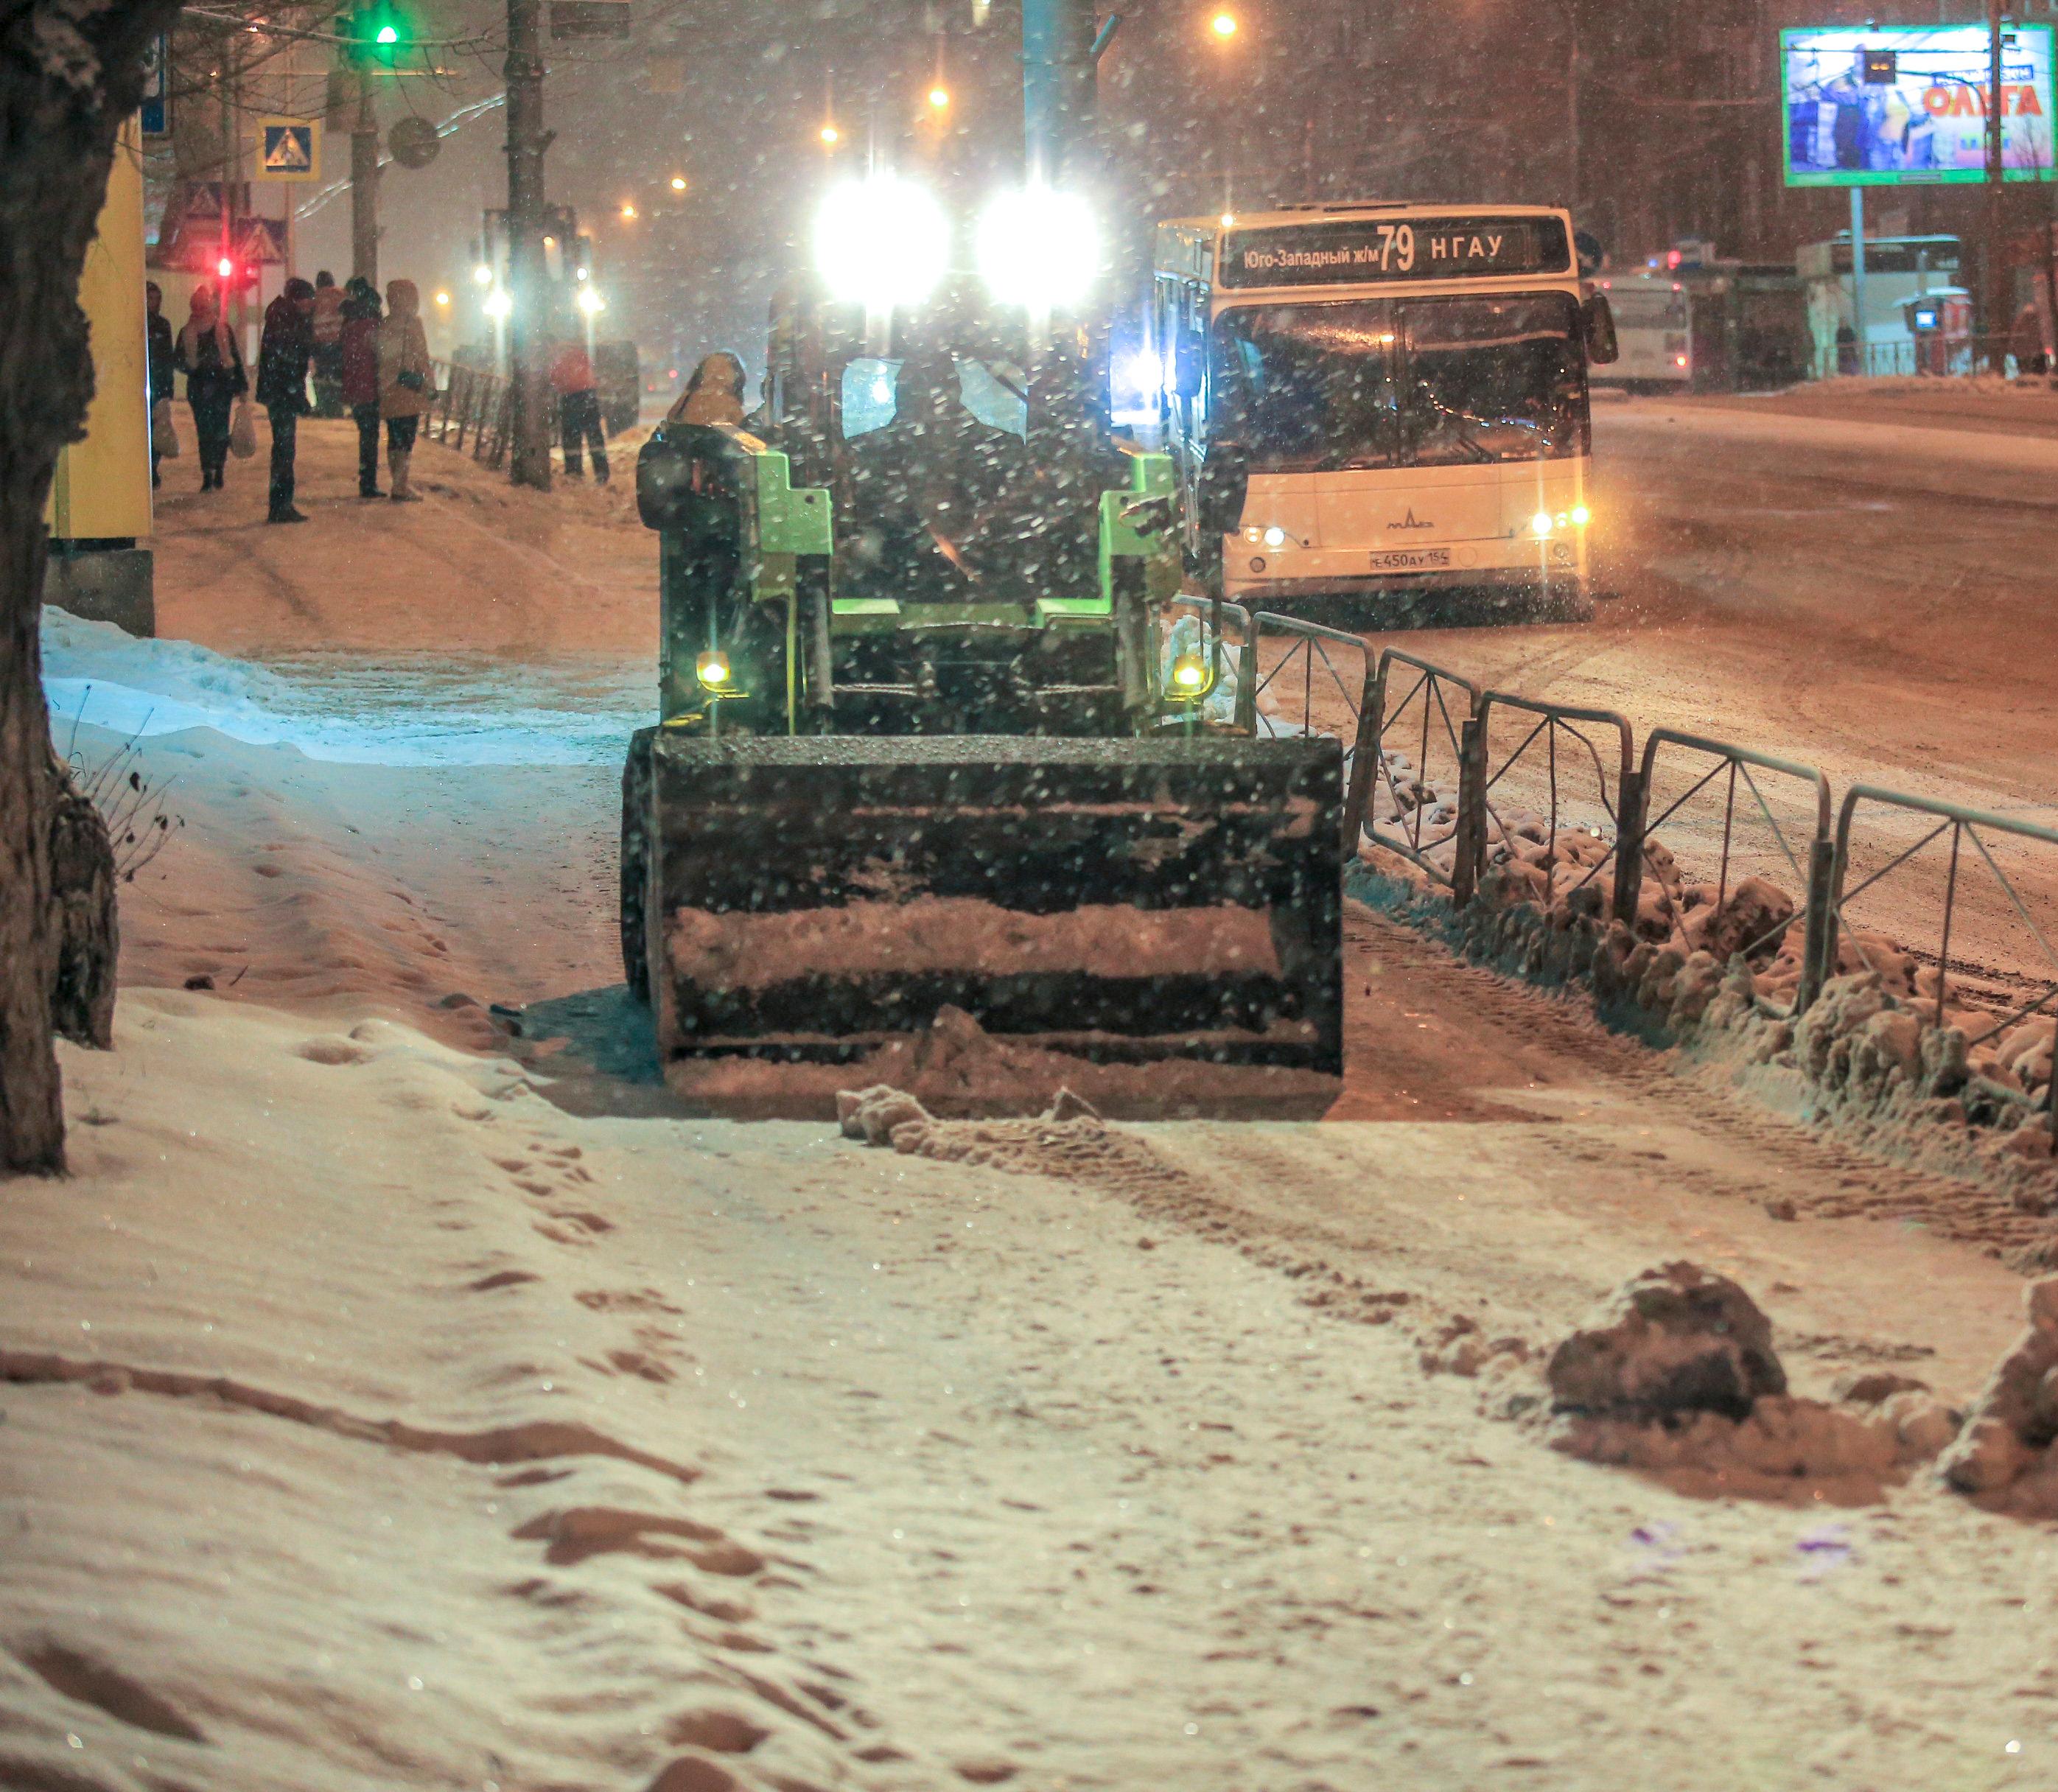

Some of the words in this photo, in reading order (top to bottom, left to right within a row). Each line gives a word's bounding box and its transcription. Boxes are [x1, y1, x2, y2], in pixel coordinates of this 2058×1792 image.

[1244, 247, 1351, 268] Юго-Западный
[1353, 245, 1378, 263] ж/м
[1377, 225, 1415, 272] 79
[1431, 236, 1502, 259] НГАУ
